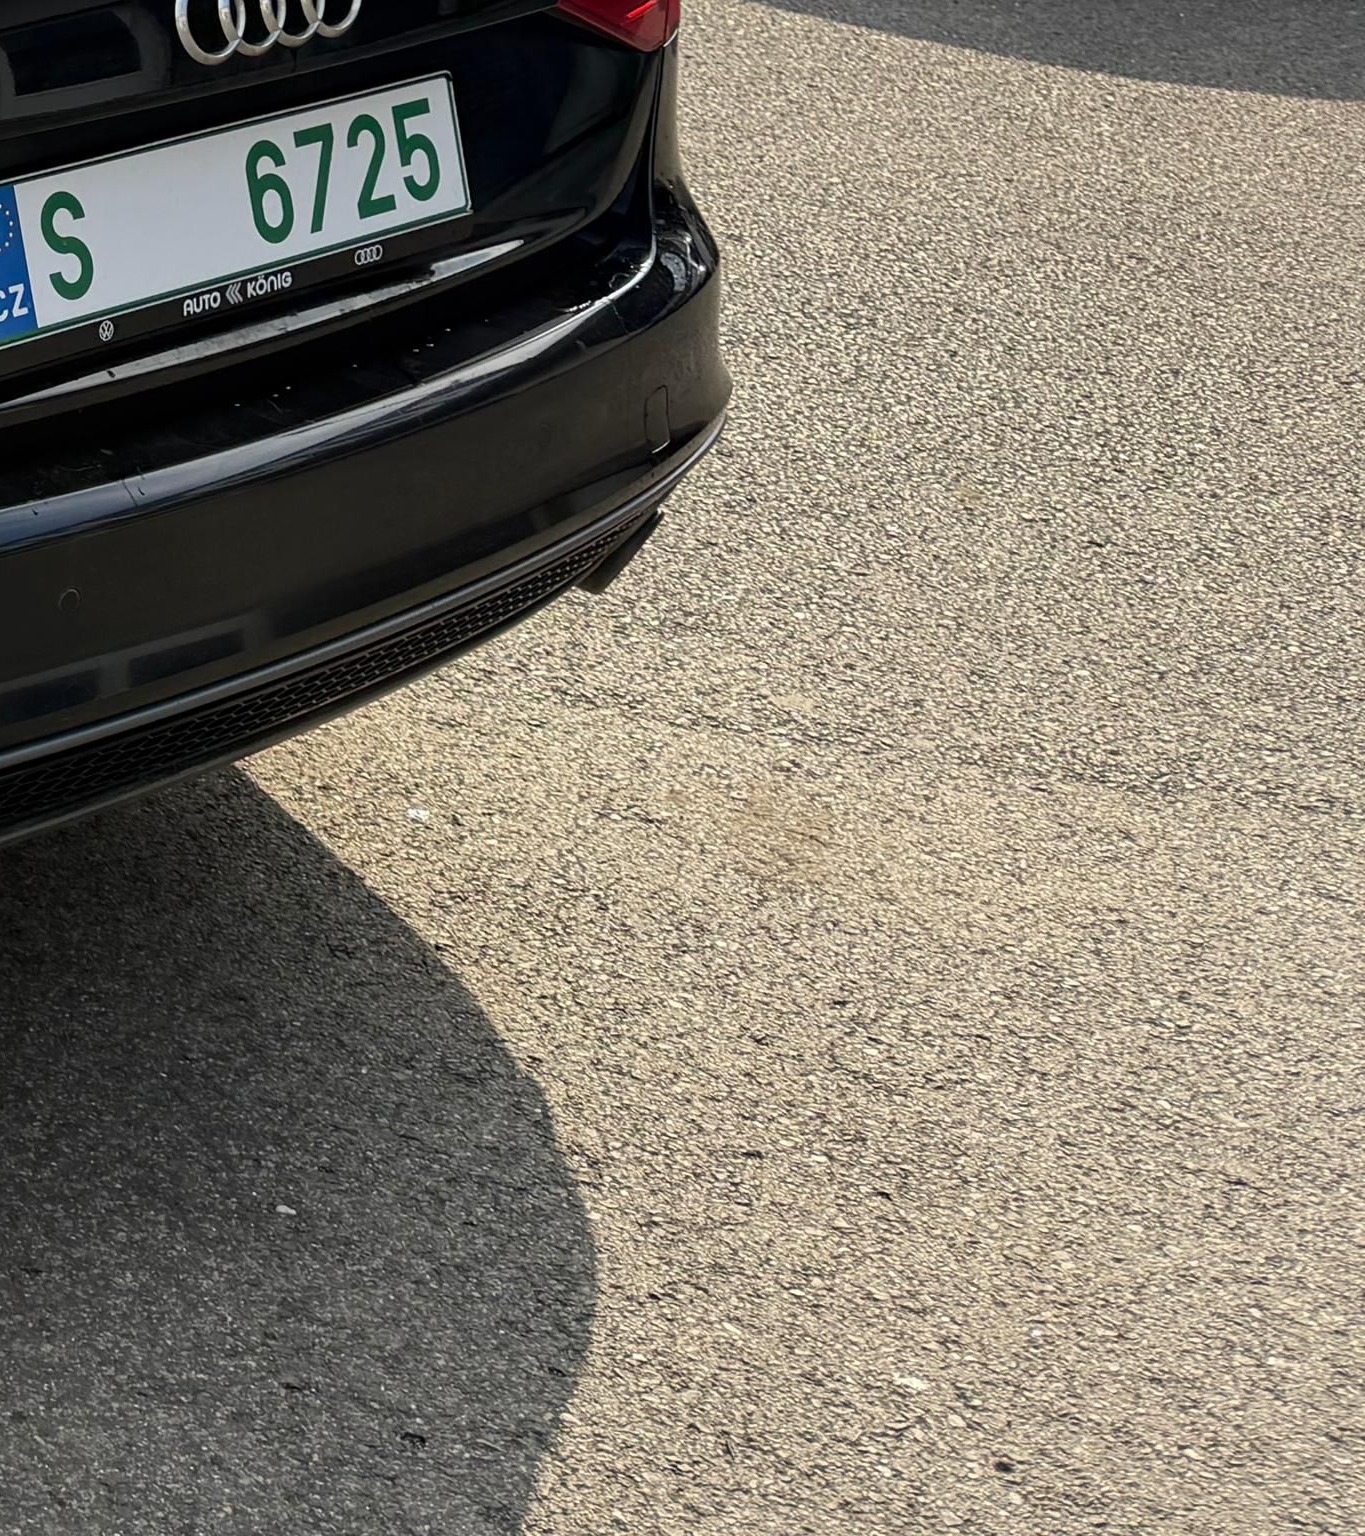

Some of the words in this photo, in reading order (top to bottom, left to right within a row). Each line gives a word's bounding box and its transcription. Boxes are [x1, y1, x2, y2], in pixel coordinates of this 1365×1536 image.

[40, 190, 94, 301] S
[245, 97, 441, 244] 6725
[183, 291, 221, 317] AUTO
[246, 271, 293, 300] KÖNIG
